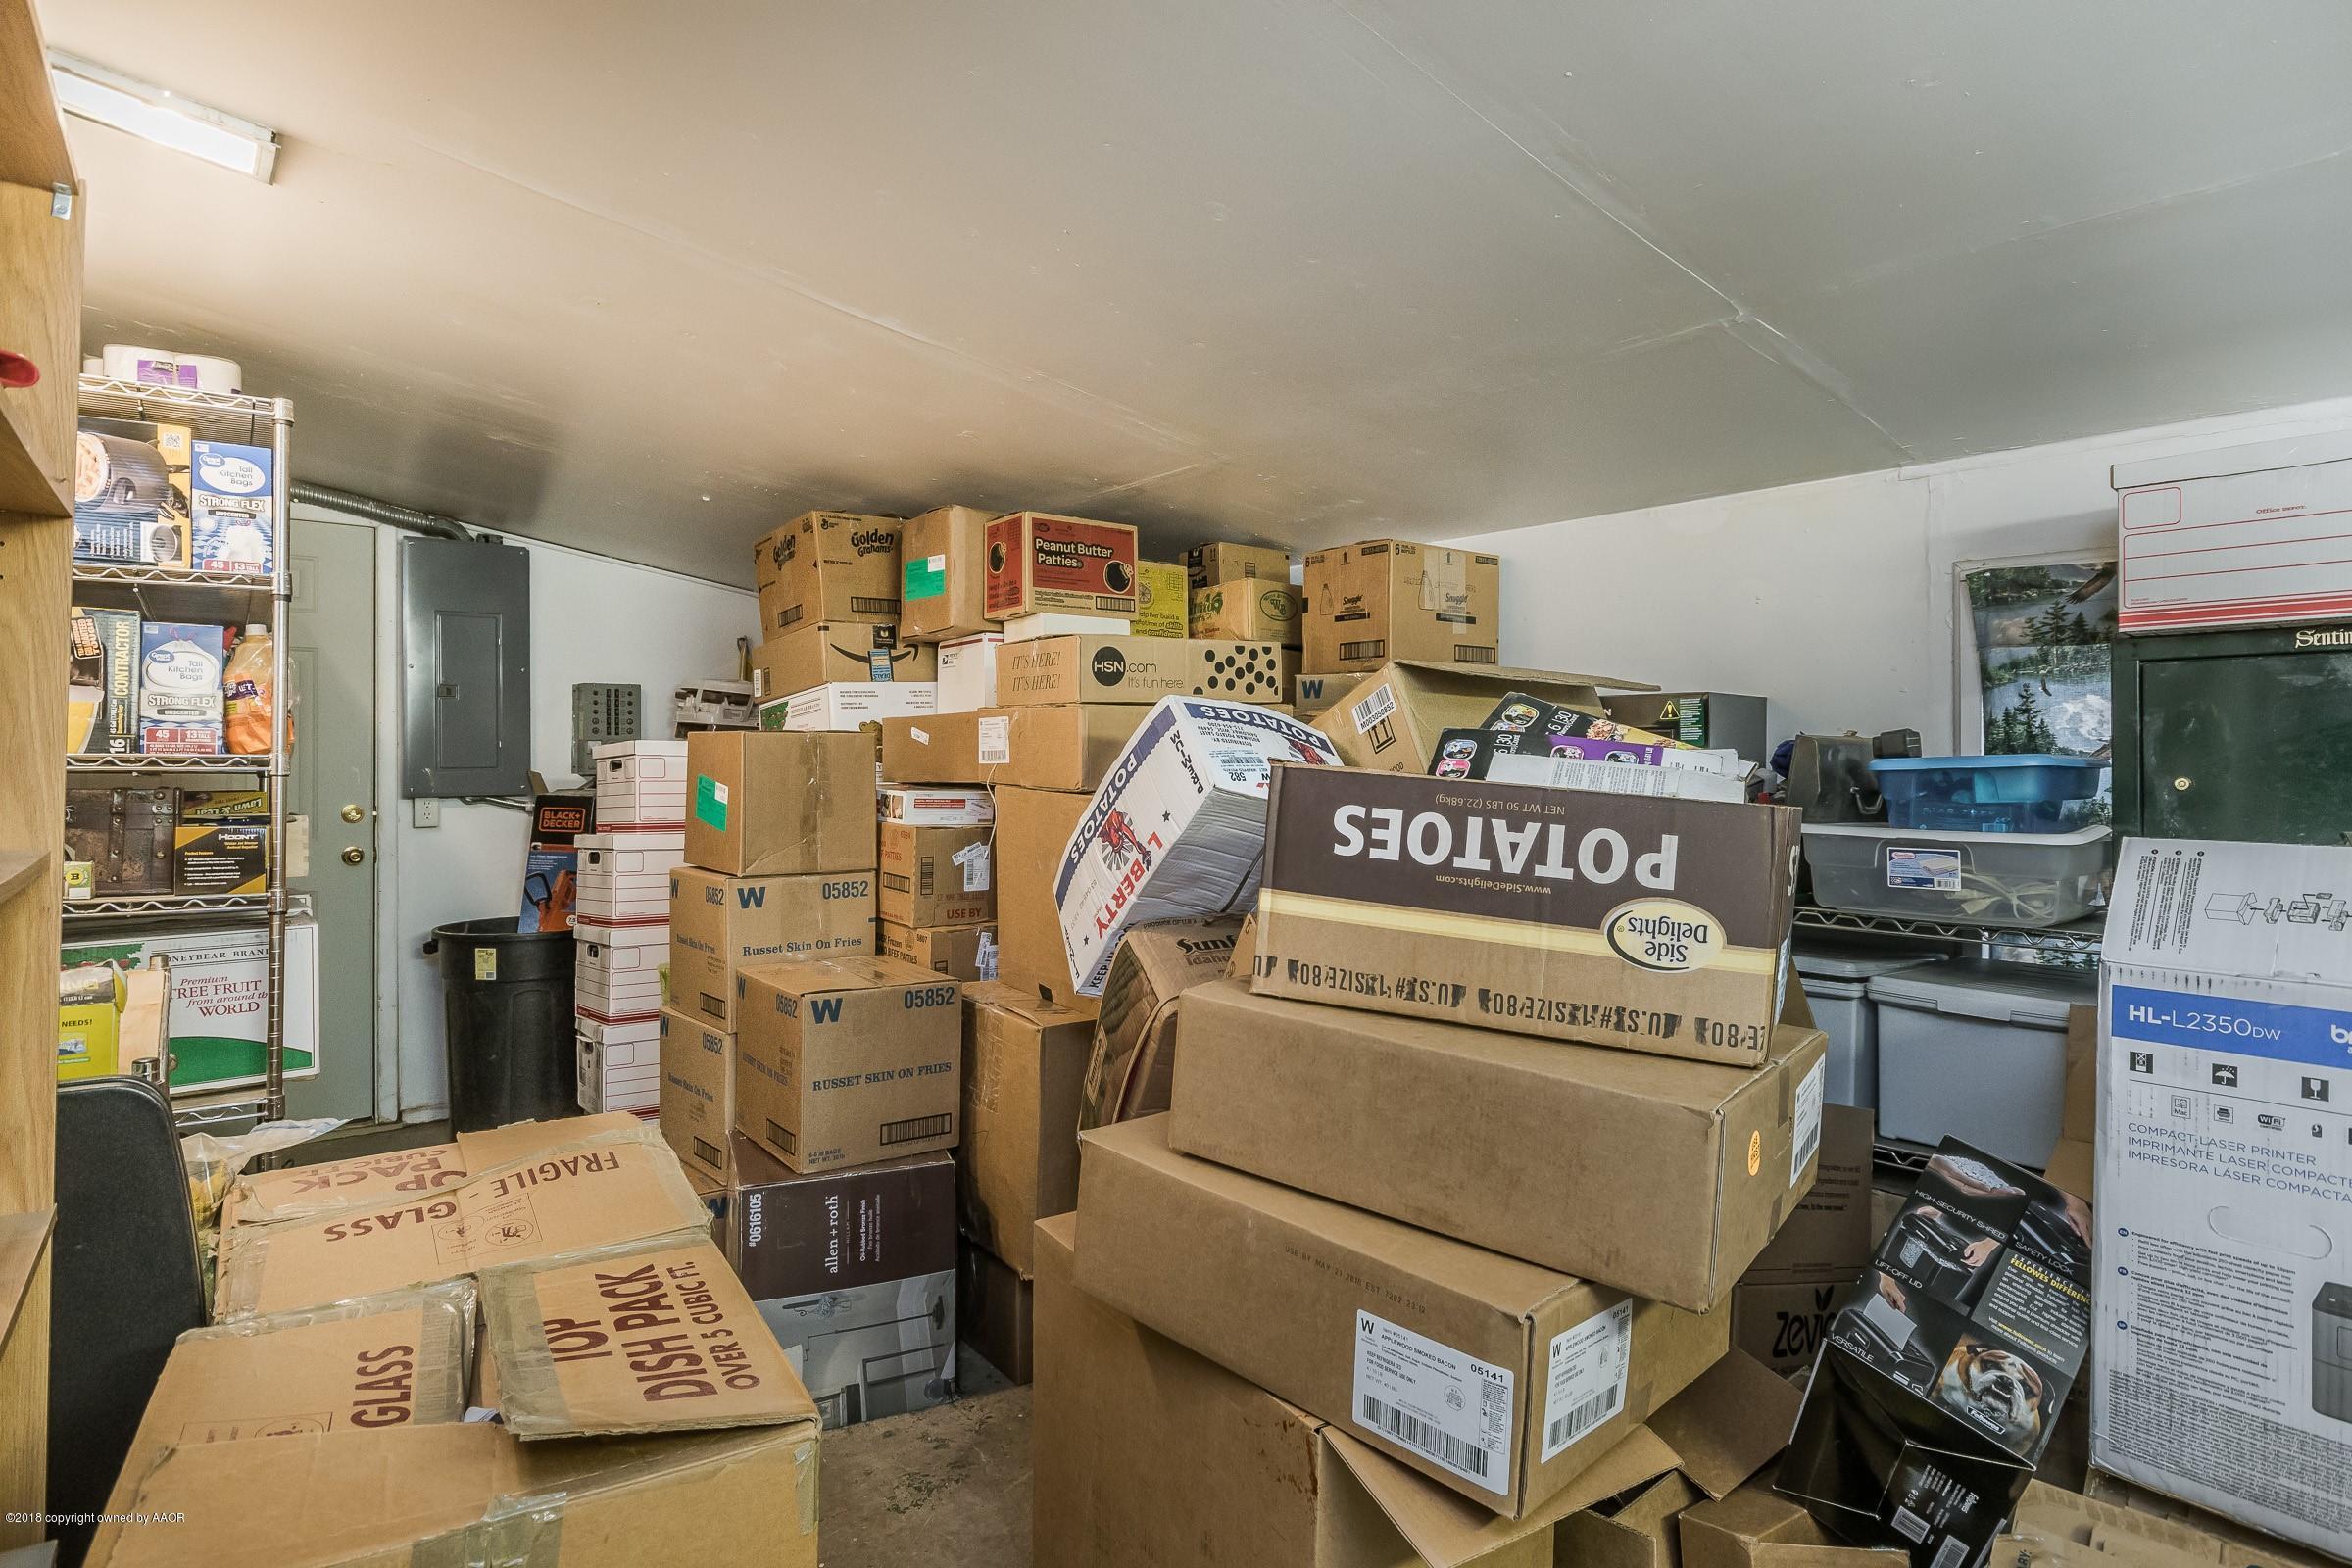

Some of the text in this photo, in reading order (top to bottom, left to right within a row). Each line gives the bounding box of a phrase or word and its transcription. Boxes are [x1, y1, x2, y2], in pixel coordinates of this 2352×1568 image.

[219, 469, 253, 480] Kitchen
[238, 465, 253, 473] Tall
[230, 478, 253, 487] Bags
[199, 494, 266, 512] STRONG FLEX
[851, 528, 895, 548] Golden
[1035, 538, 1113, 558] Peanut Butter
[858, 543, 893, 557] Grahams
[210, 560, 245, 571] 45 13
[1342, 594, 1363, 606] Snuggle
[1445, 593, 1468, 605] Snuggle
[115, 620, 131, 696] CONTRACTOR
[1011, 651, 1061, 670] IT'S HERE!
[168, 665, 204, 674] Kitchen
[180, 673, 204, 682] Bags
[1011, 674, 1061, 692] IT'S HERE!
[1128, 676, 1141, 688] It's
[1143, 676, 1158, 688] fun
[1301, 679, 1324, 699] W
[148, 695, 217, 707] STRONG FLEX
[155, 729, 198, 738] 45 13
[1199, 706, 1321, 748] POTATOES
[109, 738, 126, 754] 16
[1170, 730, 1203, 795] PREMIUM
[1229, 772, 1246, 781] 582
[222, 805, 232, 814] &
[234, 797, 263, 811] Lawn
[1070, 753, 1138, 864] POTATOES
[1435, 793, 1565, 815] NET WT 50 LBS (22.68kg)
[542, 819, 581, 829] DECKER
[543, 810, 581, 820] BLACK+
[1333, 804, 1679, 892] POTATOES
[670, 878, 679, 899] W
[822, 880, 869, 901] 05852
[1435, 874, 1552, 897] www.SideDelights.com
[705, 886, 725, 906] 05852
[737, 886, 766, 909] W
[947, 906, 982, 919] USE BY
[1628, 915, 1708, 944] Delights
[742, 936, 862, 956] Russet Skin On Fries
[887, 936, 903, 949] Frozen
[1644, 940, 1689, 963] Side
[888, 948, 918, 965] BEEF PATTIES
[180, 976, 228, 986] Premium
[1089, 963, 1110, 988] KEEP
[1326, 966, 1367, 994] SIZE
[214, 980, 262, 996] FRUIT
[737, 975, 746, 1000] W
[186, 994, 255, 1008] from around
[775, 992, 798, 1019] 05852
[904, 986, 956, 1010] 05852
[199, 1001, 260, 1017] WORLD
[810, 998, 843, 1025] W
[1526, 996, 1568, 1025] SIZE
[61, 1018, 93, 1028] NEEDS!
[659, 1015, 669, 1037] W
[2129, 1004, 2281, 1041] HL-L2350DW
[702, 1031, 723, 1055] 05852
[812, 1062, 952, 1092] RUSSET SKIN ON FRIES
[2128, 1122, 2318, 1166] COMPACT LASER PRINTER
[2128, 1136, 2267, 1172] IMPRIMANTE LASER
[353, 1149, 448, 1171] CUBIC
[292, 1156, 444, 1195] PACK
[2128, 1150, 2352, 1203] IMPRESORA COMPACTA
[324, 1200, 458, 1243] GLASS
[494, 1150, 621, 1200] FRAGILE
[749, 1193, 762, 1248] #0616105
[1914, 1189, 2007, 1240] HIGH-SECURITY SHRED
[825, 1195, 839, 1274] allen roth
[2132, 1231, 2194, 1250] Engineered efficiency
[1315, 1258, 1331, 1271] MAY
[2014, 1241, 2075, 1276] SAFETY LOCK
[1874, 1259, 1924, 1289] LIFT-OFF LID
[2009, 1257, 2095, 1307] FELLOWES DIFFERENC
[1612, 1305, 1629, 1320] 05141
[595, 1262, 718, 1402] DISH PACK
[666, 1261, 761, 1391] OVER 5 CUBIC FT.
[1361, 1317, 1374, 1335] W
[1366, 1350, 1376, 1359] KEEP
[1381, 1334, 1456, 1370] APPLEWOOD SMOKED BACON
[1552, 1342, 1562, 1358] W
[1831, 1332, 1875, 1363] VERSATILE
[1470, 1363, 1504, 1383] 05141
[350, 1344, 414, 1429] GLASS
[1970, 1408, 2002, 1432] Fellowes
